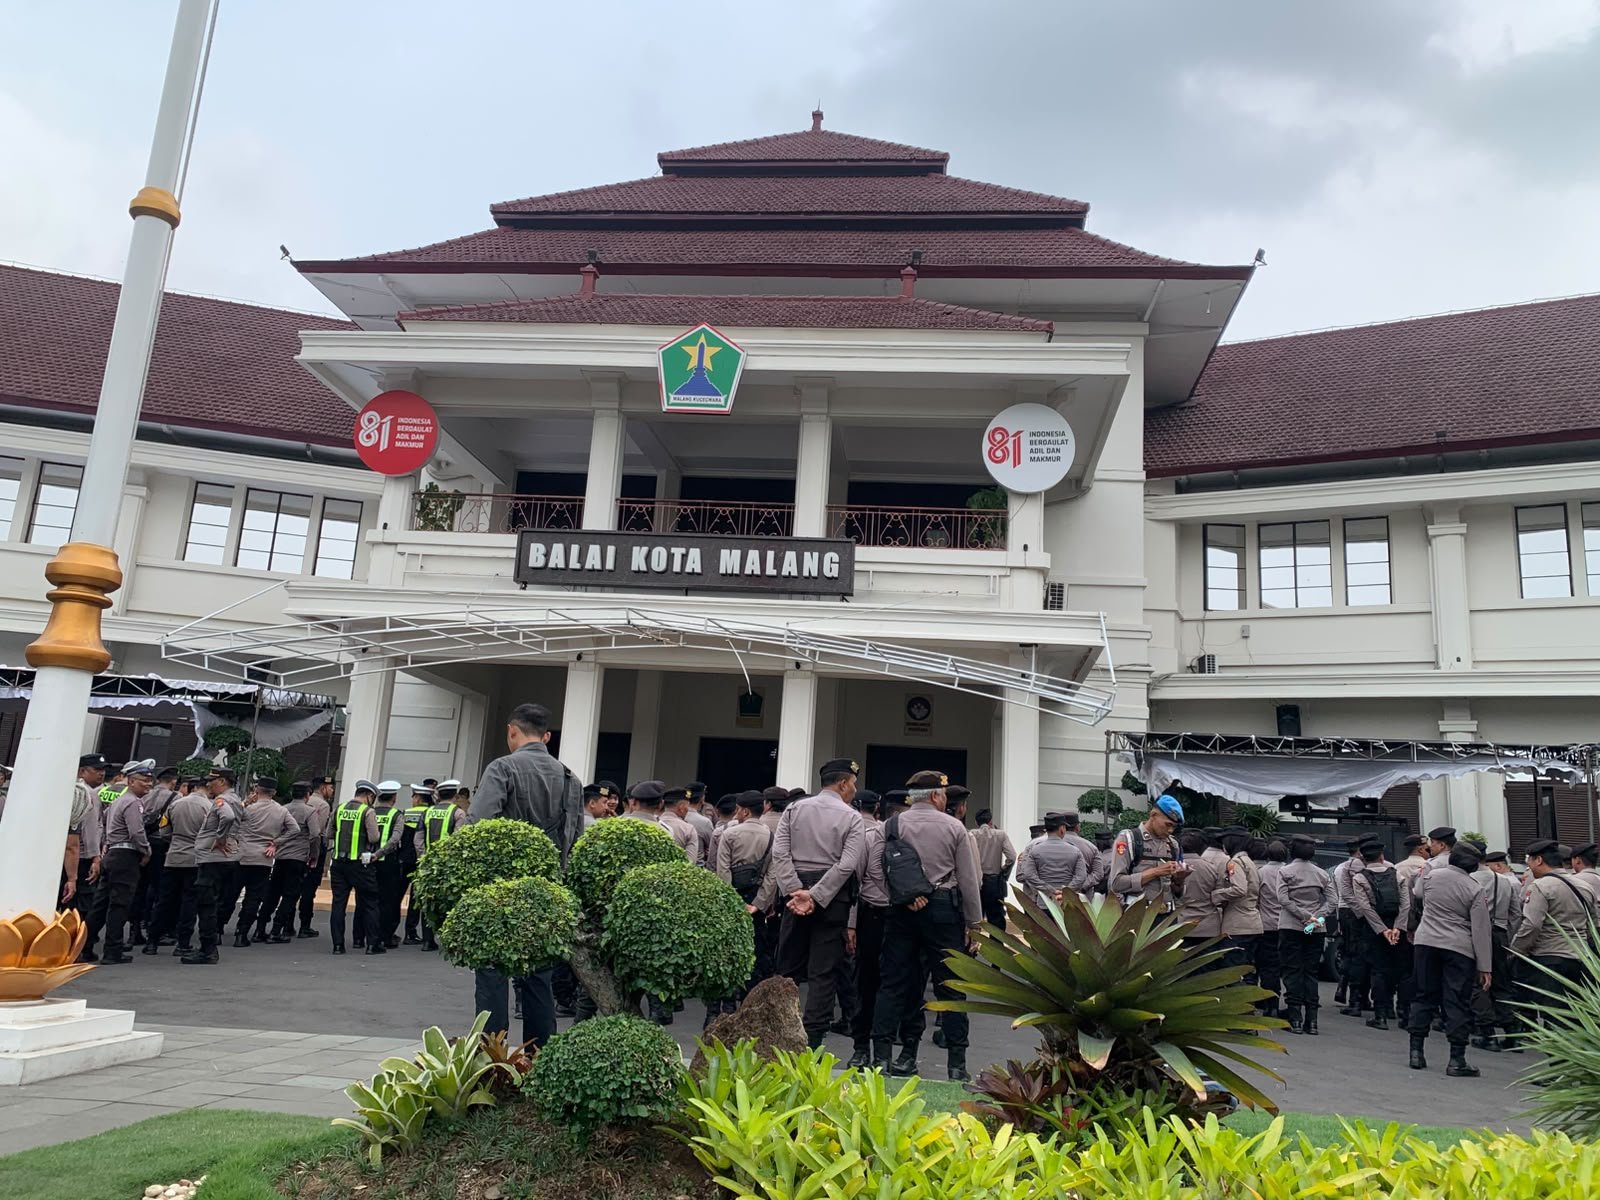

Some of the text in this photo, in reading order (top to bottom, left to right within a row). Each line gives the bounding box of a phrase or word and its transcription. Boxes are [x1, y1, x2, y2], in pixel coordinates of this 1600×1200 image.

[397, 417, 431, 425] INDONESIA
[358, 411, 394, 452] 81
[397, 425, 433, 433] BERDAULAT
[1029, 430, 1066, 438] INDONESIA
[395, 441, 424, 449] MAKMUR
[987, 426, 1025, 469] 81
[1029, 455, 1061, 463] MAKMUR
[528, 542, 840, 578] BALAI KOTA MALANG
[99, 791, 120, 802] POLI
[338, 810, 360, 820] POLISI
[427, 809, 449, 818] POLISI
